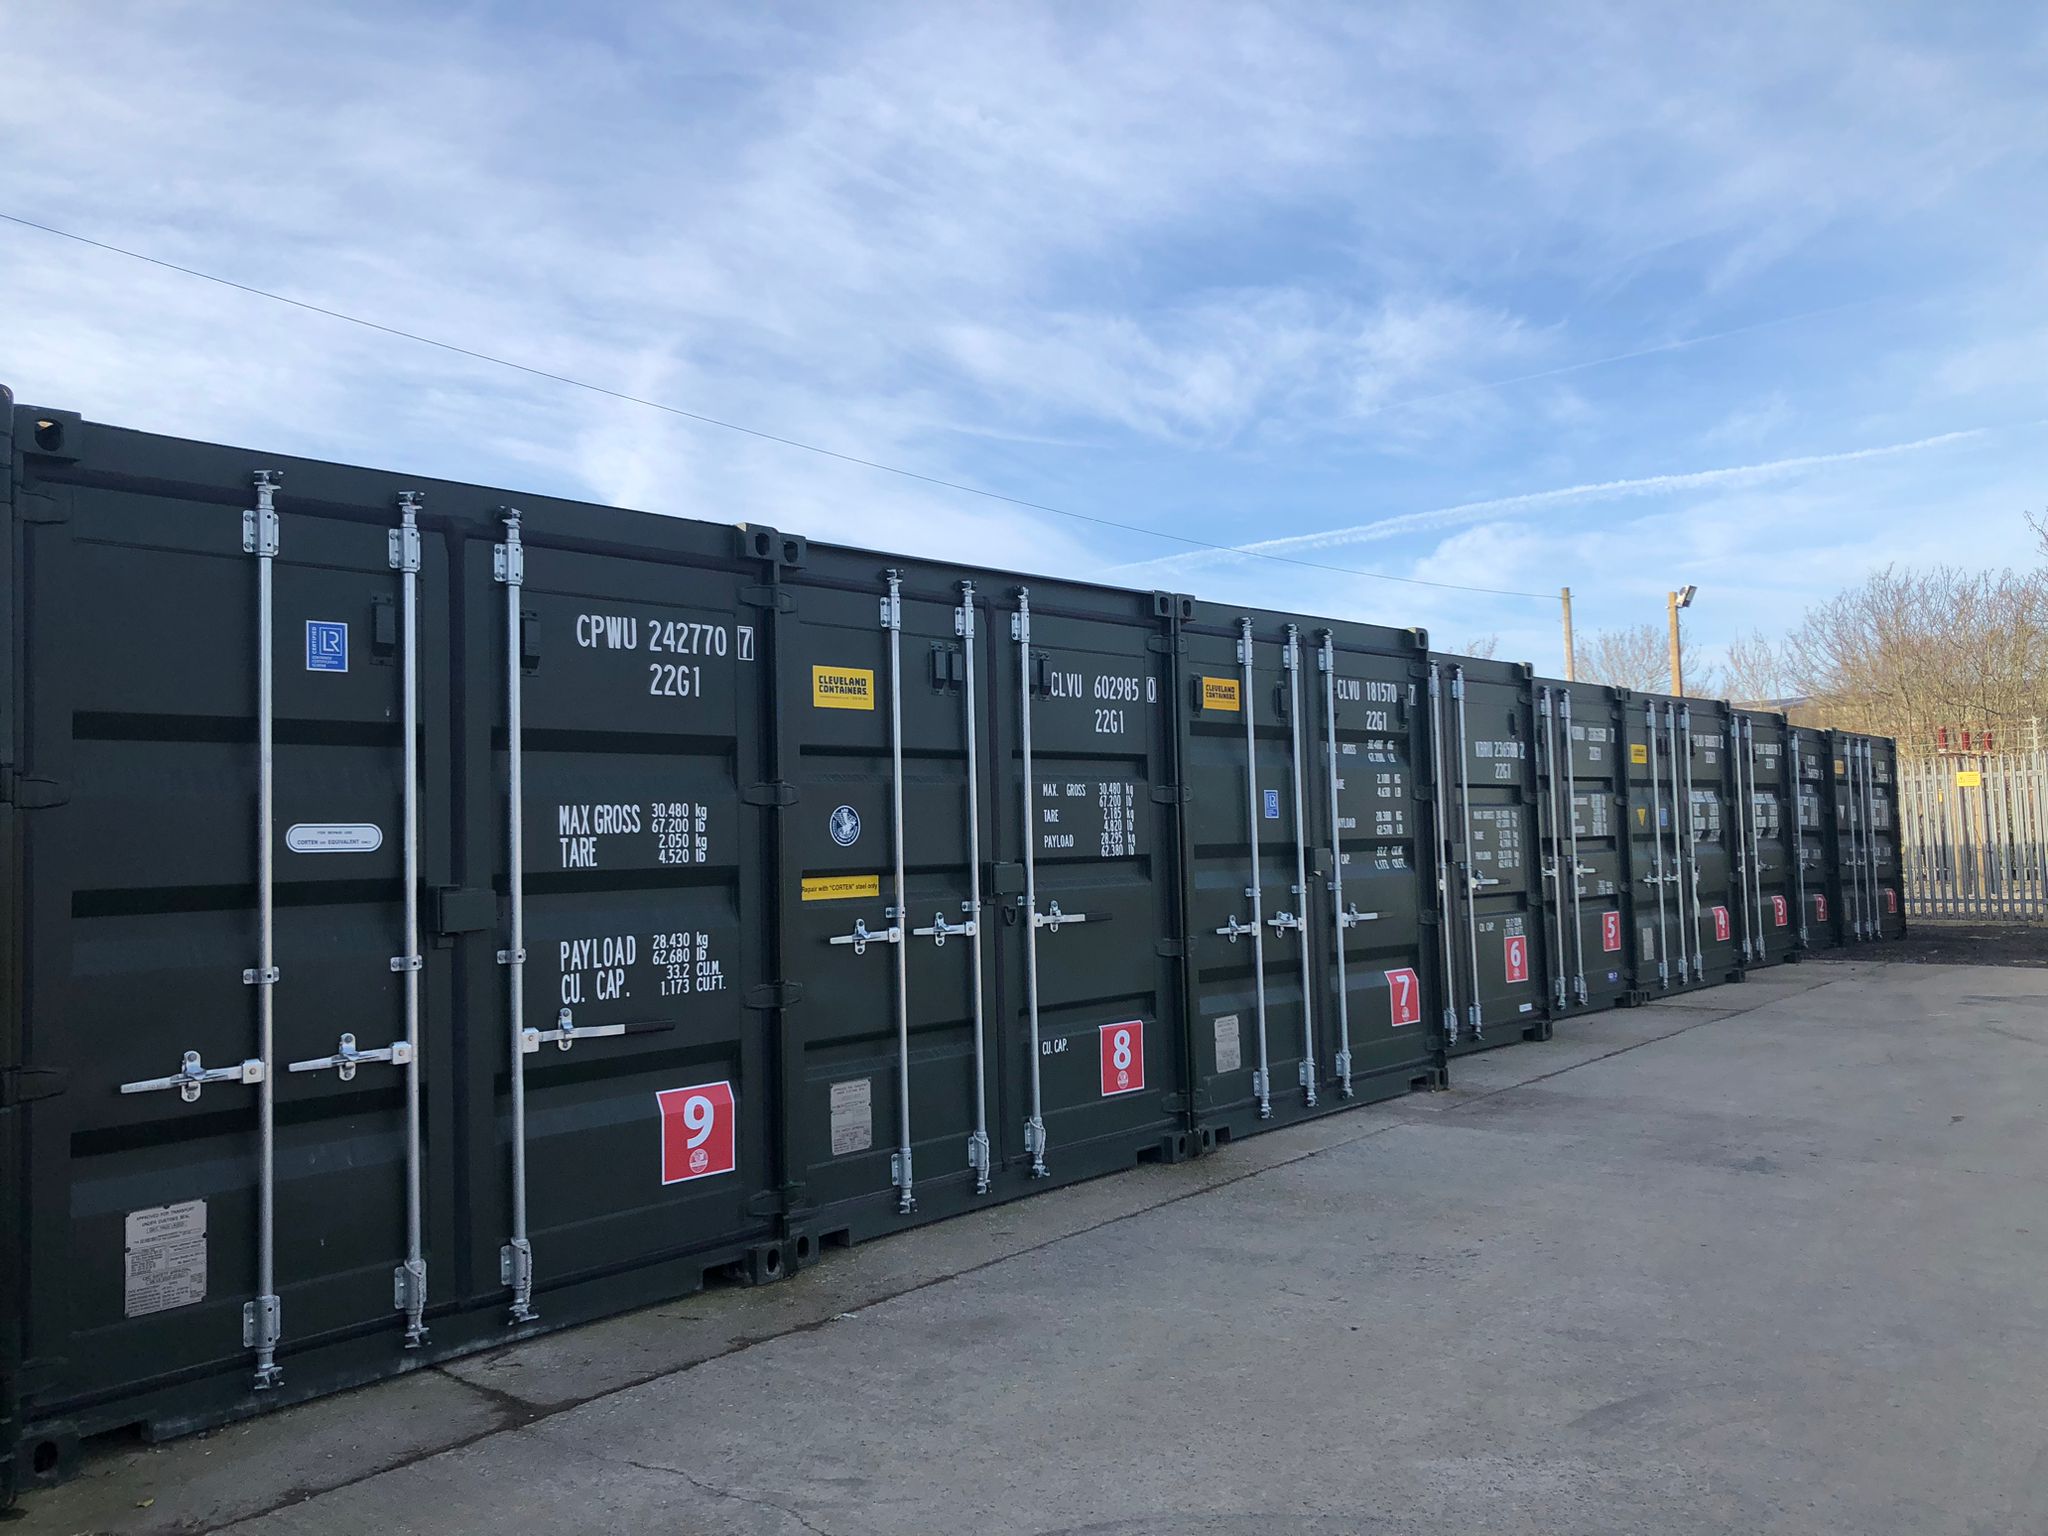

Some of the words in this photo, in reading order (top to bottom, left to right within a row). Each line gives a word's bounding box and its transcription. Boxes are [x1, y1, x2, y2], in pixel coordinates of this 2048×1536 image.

[323, 631, 340, 652] LR
[576, 614, 638, 649] CPWU
[649, 620, 727, 656] 242770
[739, 628, 751, 658] 7
[650, 663, 700, 697] 22G1
[818, 675, 866, 686] CLEVELAND
[1051, 672, 1082, 698] CLVU
[1094, 676, 1139, 701] 602985
[1337, 680, 1360, 700] CLVU
[1366, 682, 1397, 703] 181570
[1095, 708, 1124, 734] 22G1
[1366, 710, 1387, 730] 22G1
[1043, 784, 1059, 796] MAX.
[1066, 784, 1086, 796] GROSS
[1099, 782, 1121, 795] 30.480
[1126, 782, 1133, 798] kg
[1099, 795, 1121, 807] 67.200
[559, 805, 590, 835] MAX
[594, 805, 641, 834] GROSS
[651, 803, 689, 818] 30.480
[695, 803, 707, 821] kg
[1044, 809, 1059, 822] TARE
[1104, 807, 1122, 820] 2.185
[1127, 807, 1134, 822] kg
[652, 819, 689, 833] 67.200
[695, 818, 706, 833] lb
[658, 834, 689, 848] 2.050
[695, 834, 707, 852] kg
[1044, 834, 1074, 848] PAYLOAD
[1101, 832, 1122, 845] 28.295
[1128, 832, 1135, 846] kg
[560, 837, 598, 868] TARE
[658, 849, 689, 864] 4.520
[696, 849, 706, 863] lb
[1777, 900, 1784, 916] 3
[1819, 899, 1824, 912] 2
[1608, 916, 1615, 938] 5
[1719, 910, 1725, 928] 4
[652, 932, 690, 949] 28.430
[696, 932, 708, 949] kg
[560, 935, 636, 972] PAYLOAD
[652, 948, 690, 965] 62.680
[697, 947, 707, 962] lb
[1510, 941, 1521, 967] 6
[666, 964, 689, 980] 33.2
[561, 973, 585, 1005] CU.
[661, 979, 690, 996] 1.173
[1396, 975, 1409, 1006] 7
[1042, 1041, 1053, 1055] CU.
[1054, 1038, 1068, 1053] CAP.
[1113, 1030, 1131, 1070] 8
[684, 1096, 714, 1149] 9
